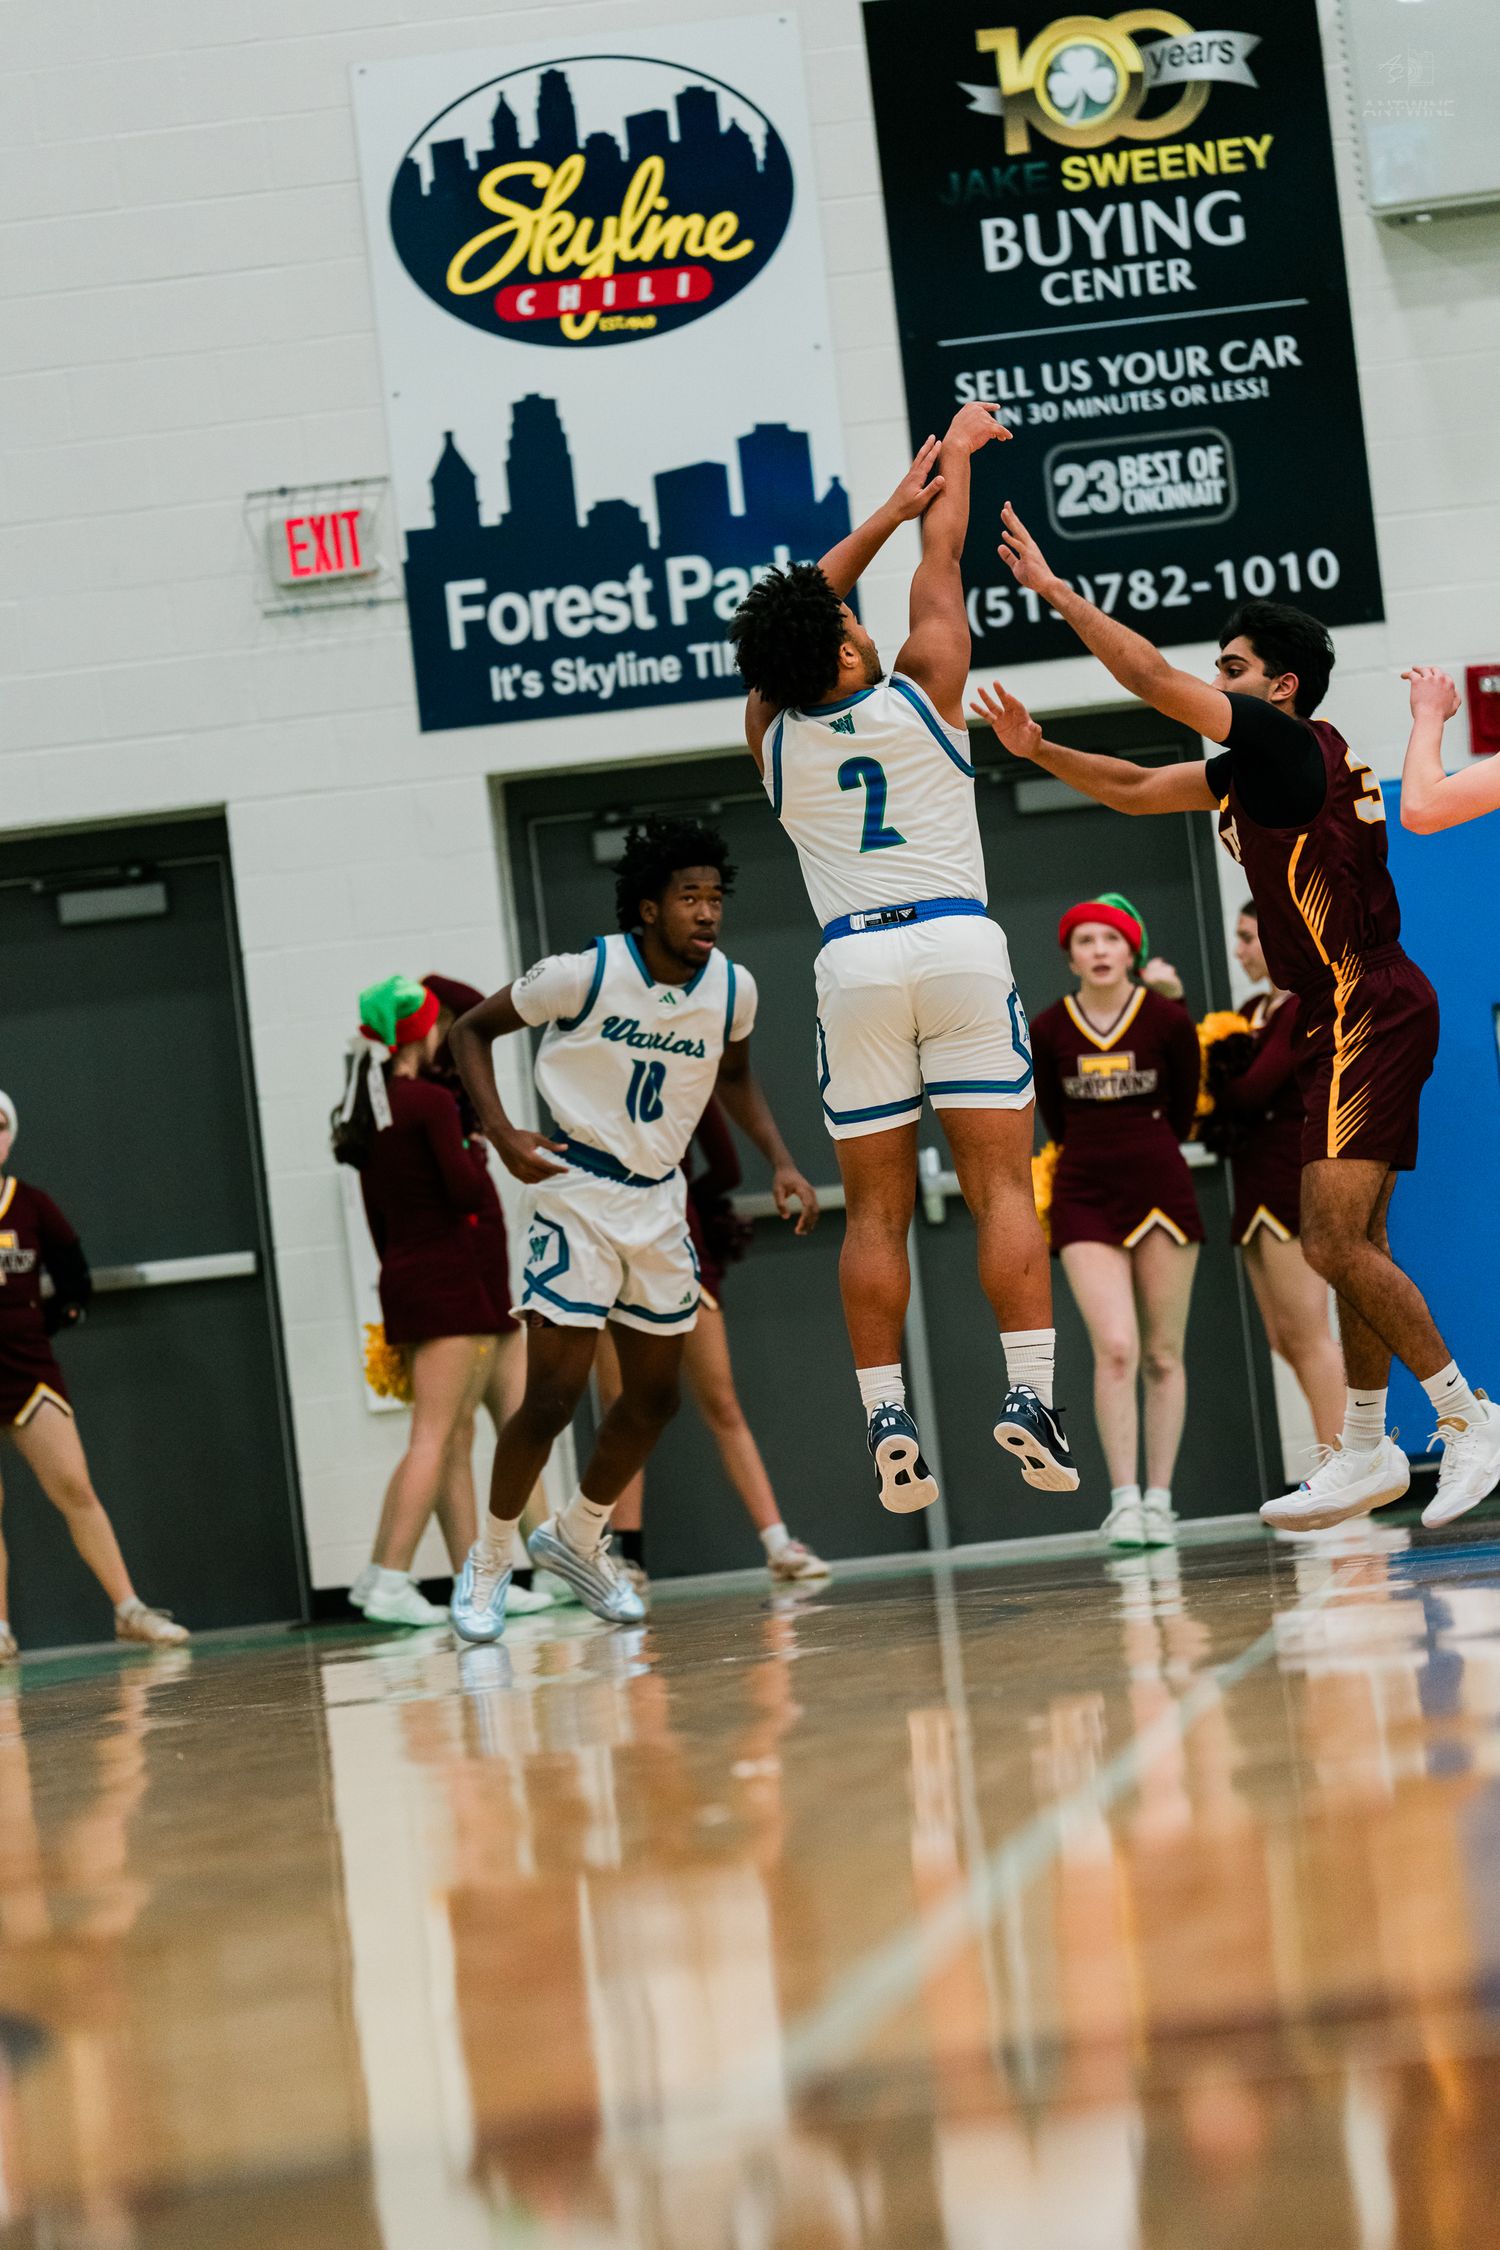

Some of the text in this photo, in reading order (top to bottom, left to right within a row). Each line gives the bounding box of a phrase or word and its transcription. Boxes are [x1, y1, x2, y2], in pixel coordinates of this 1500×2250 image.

[1148, 38, 1237, 80] years
[942, 134, 1274, 205] JAKE SWEENEY
[446, 154, 754, 340] Skyline
[980, 190, 1247, 273] BUYING
[515, 272, 690, 315] CHILI
[1040, 258, 1197, 306] CENTER
[954, 335, 1303, 405] SELL US YOUR CAR
[1026, 400, 1059, 425] 30
[1062, 389, 1168, 420] MINUTES
[1170, 384, 1208, 408] OR
[1211, 376, 1270, 403] LESS!
[1053, 444, 1225, 519] 23 BEST OF
[286, 509, 362, 579] EXIT
[444, 563, 658, 650] Forest
[490, 664, 545, 702] It's
[551, 651, 683, 699] Skyline
[837, 756, 908, 854] 2
[601, 1015, 706, 1059] Warriors
